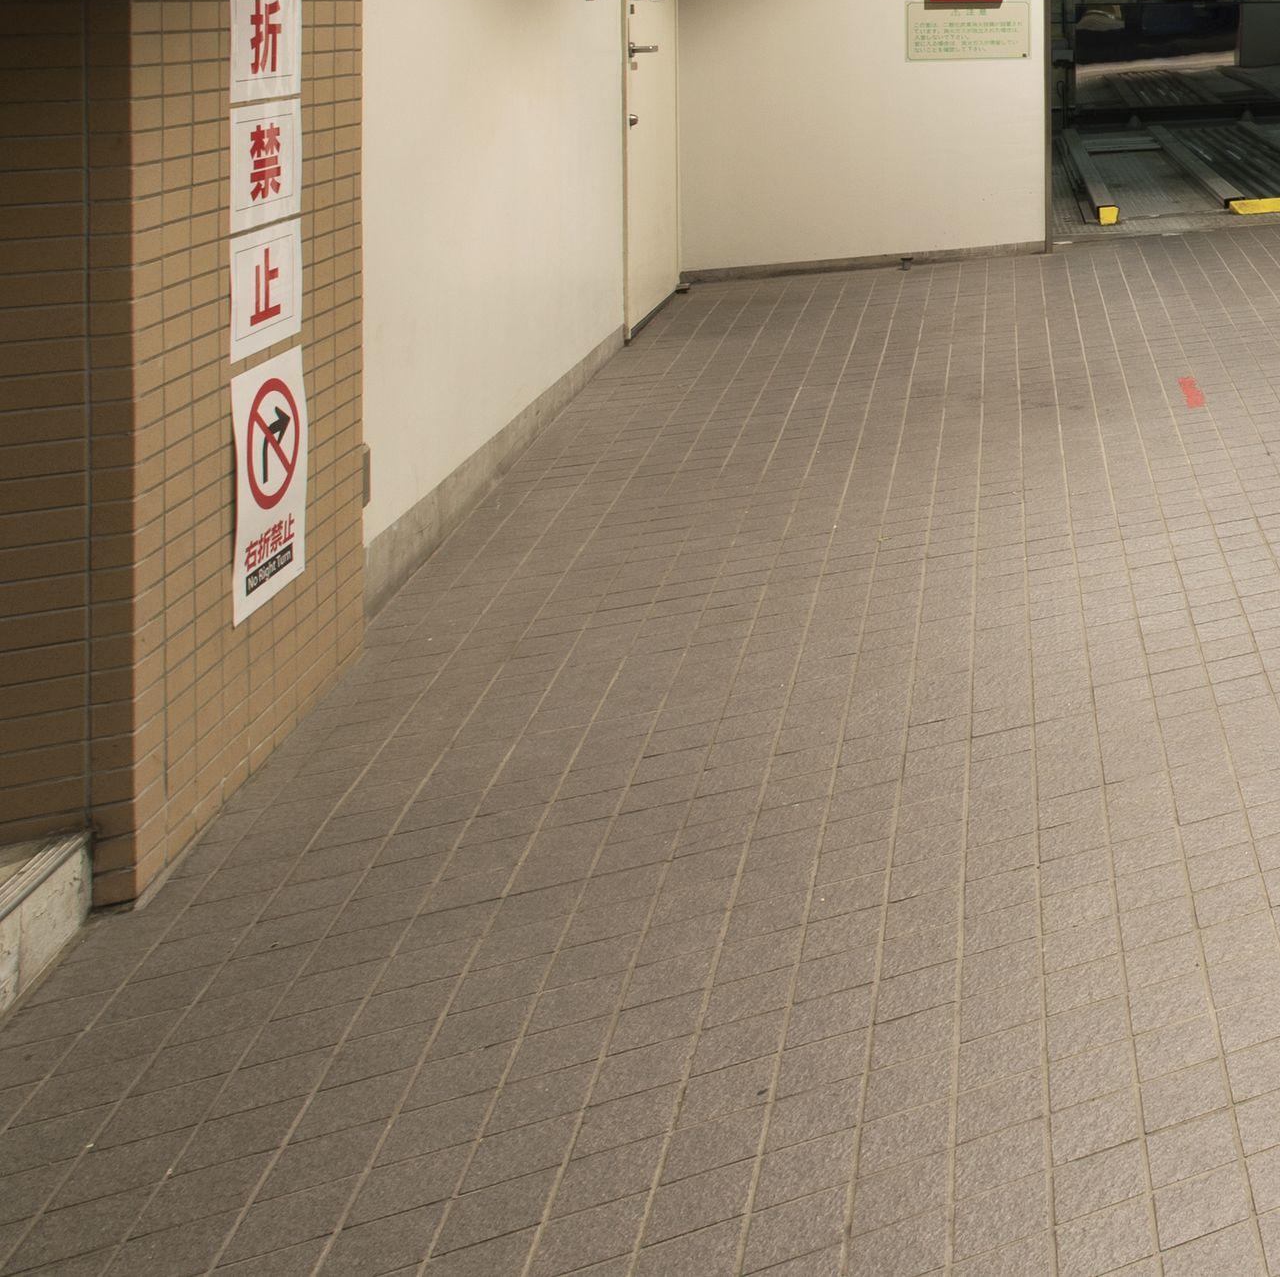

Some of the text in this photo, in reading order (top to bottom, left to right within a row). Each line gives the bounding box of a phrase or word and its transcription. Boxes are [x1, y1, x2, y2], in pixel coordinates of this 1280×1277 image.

[244, 512, 295, 573] 右折禁止
[247, 550, 292, 590] No Right Turn
